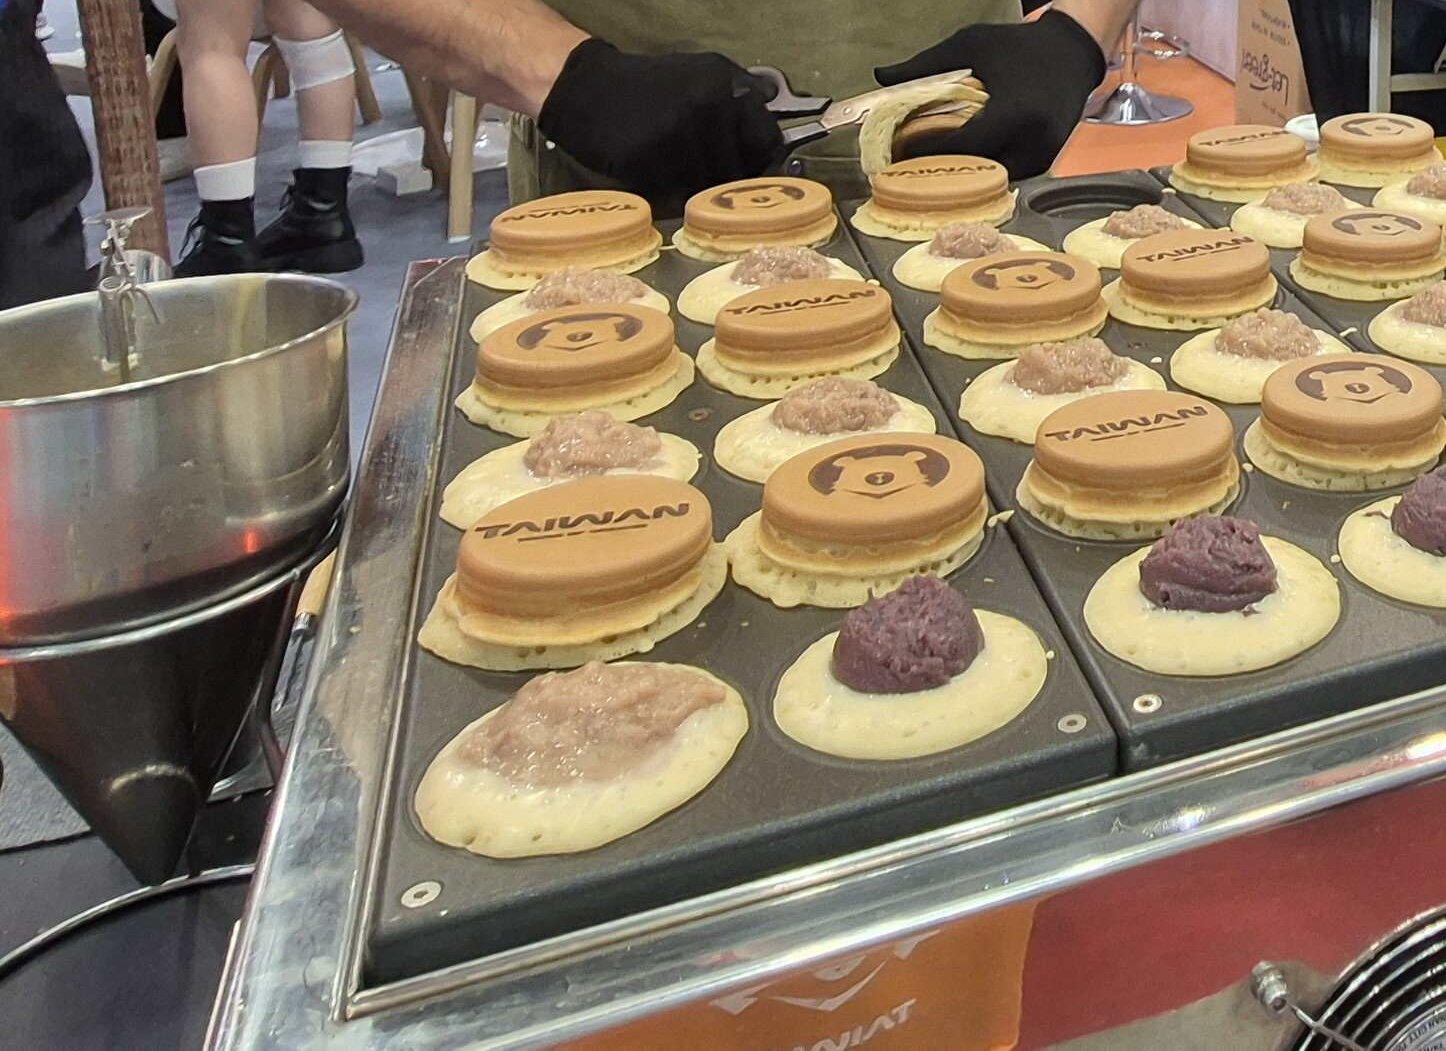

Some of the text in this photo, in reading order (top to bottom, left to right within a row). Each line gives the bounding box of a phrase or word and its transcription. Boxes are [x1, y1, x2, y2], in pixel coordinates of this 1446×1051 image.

[1197, 128, 1290, 147] TAIWAN
[881, 164, 999, 179] TAIWAN
[500, 203, 638, 224] TAIWAN
[1135, 235, 1255, 264] TAIWAN
[724, 288, 876, 316] TAIWAN
[1044, 404, 1210, 441] TAIWAN
[474, 501, 691, 541] TAIWAN
